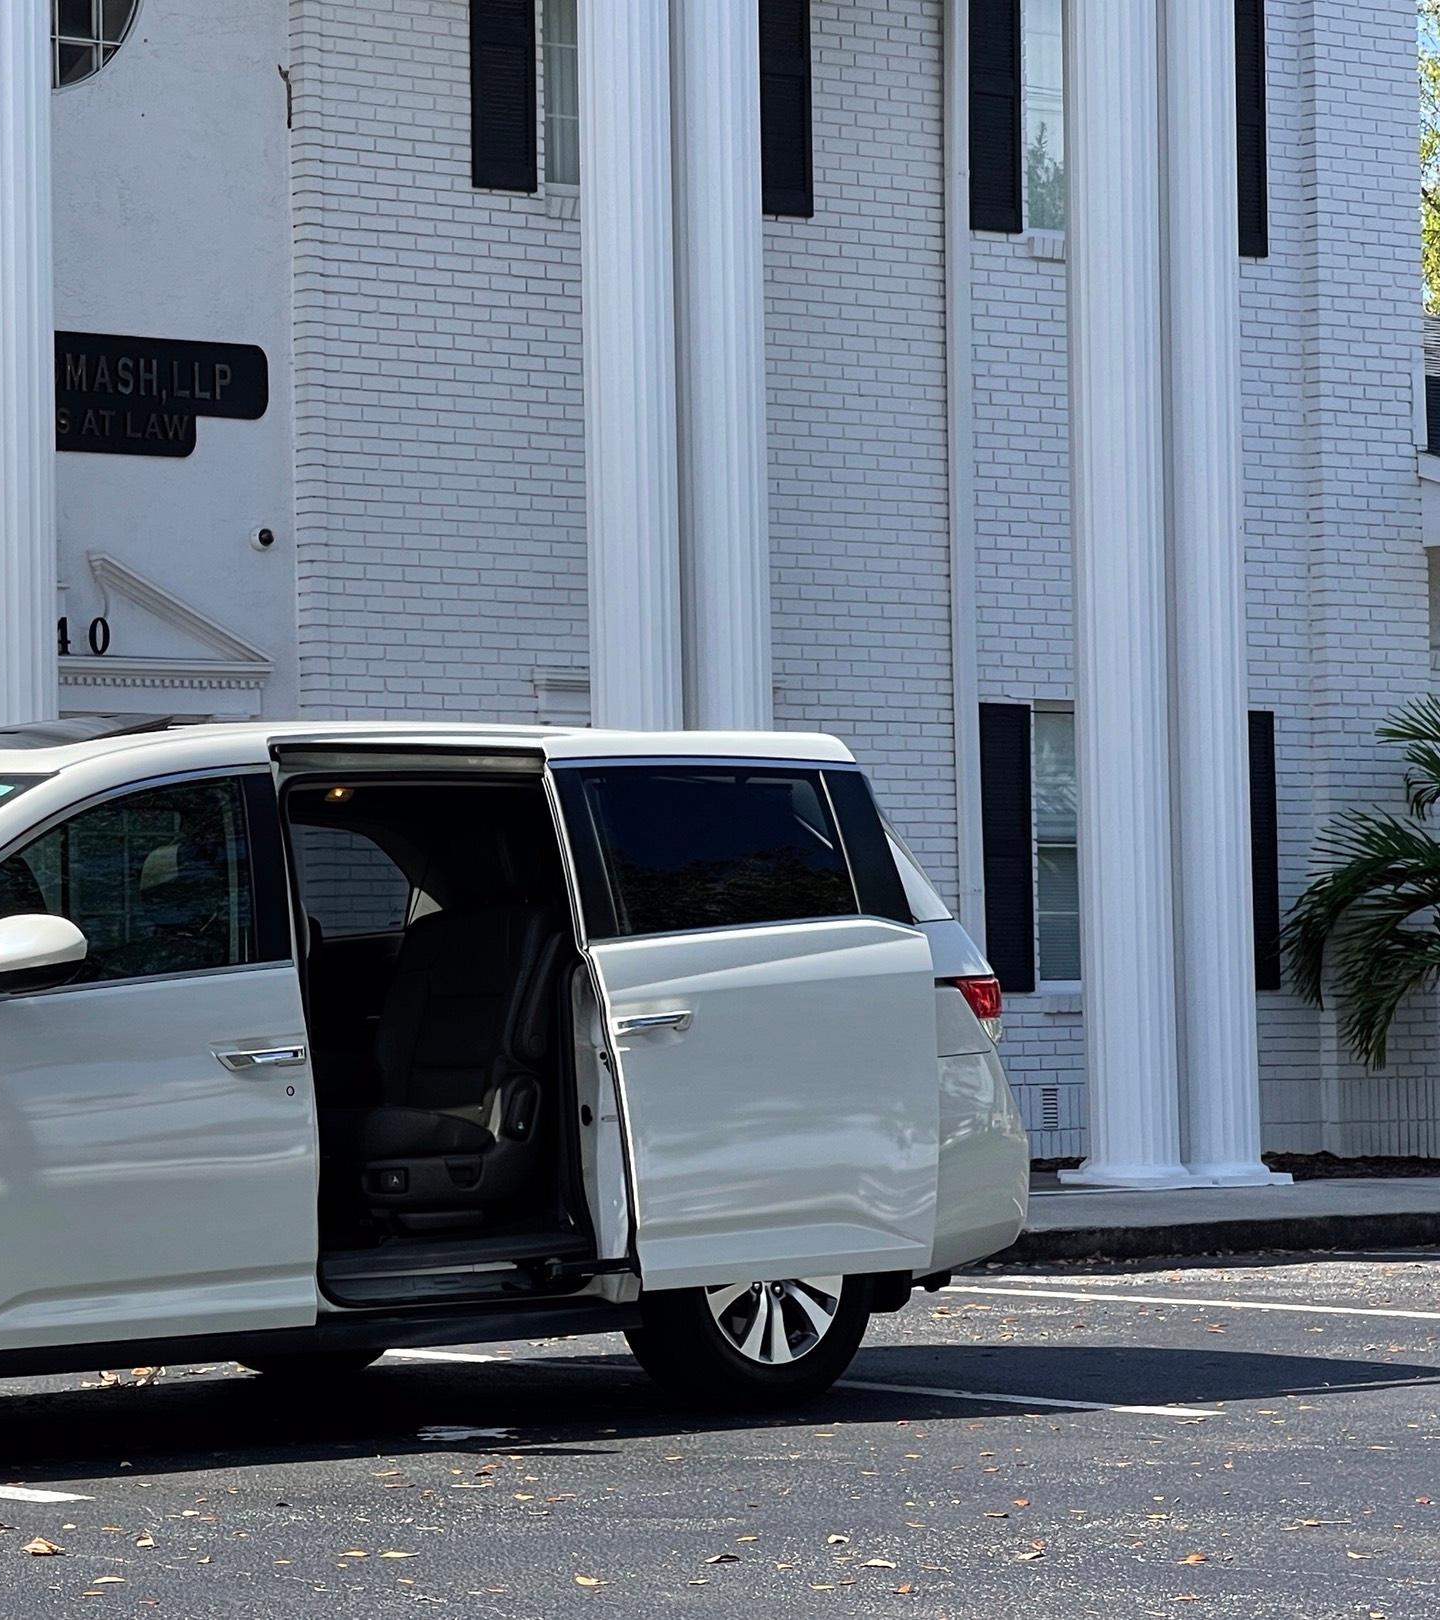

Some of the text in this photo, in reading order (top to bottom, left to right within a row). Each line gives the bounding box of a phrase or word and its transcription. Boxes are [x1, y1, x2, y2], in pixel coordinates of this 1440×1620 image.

[56, 352, 232, 405] MASH,LLP
[81, 409, 116, 436] AT
[125, 411, 189, 440] LAW
